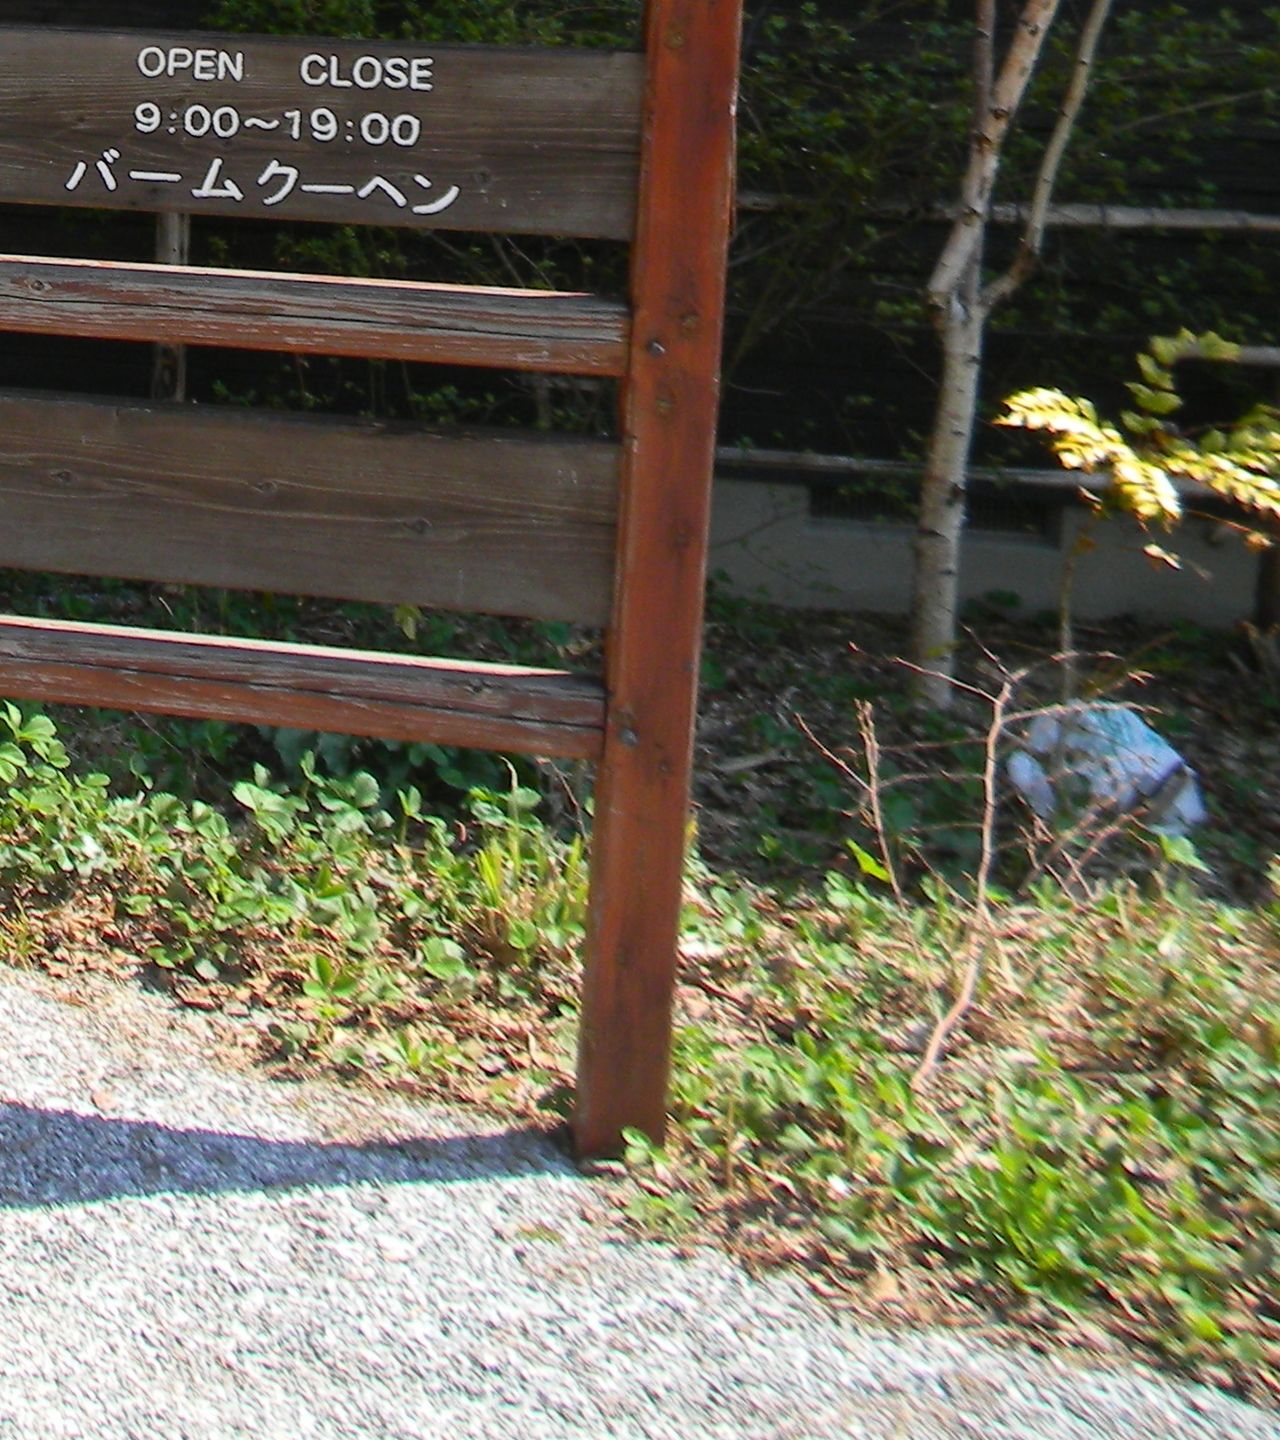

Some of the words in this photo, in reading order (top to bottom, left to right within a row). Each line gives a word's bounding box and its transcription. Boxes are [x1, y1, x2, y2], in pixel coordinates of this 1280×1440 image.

[137, 46, 244, 82] OPEN
[300, 53, 434, 91] CLOSE
[65, 147, 460, 215] バームクーヘン
